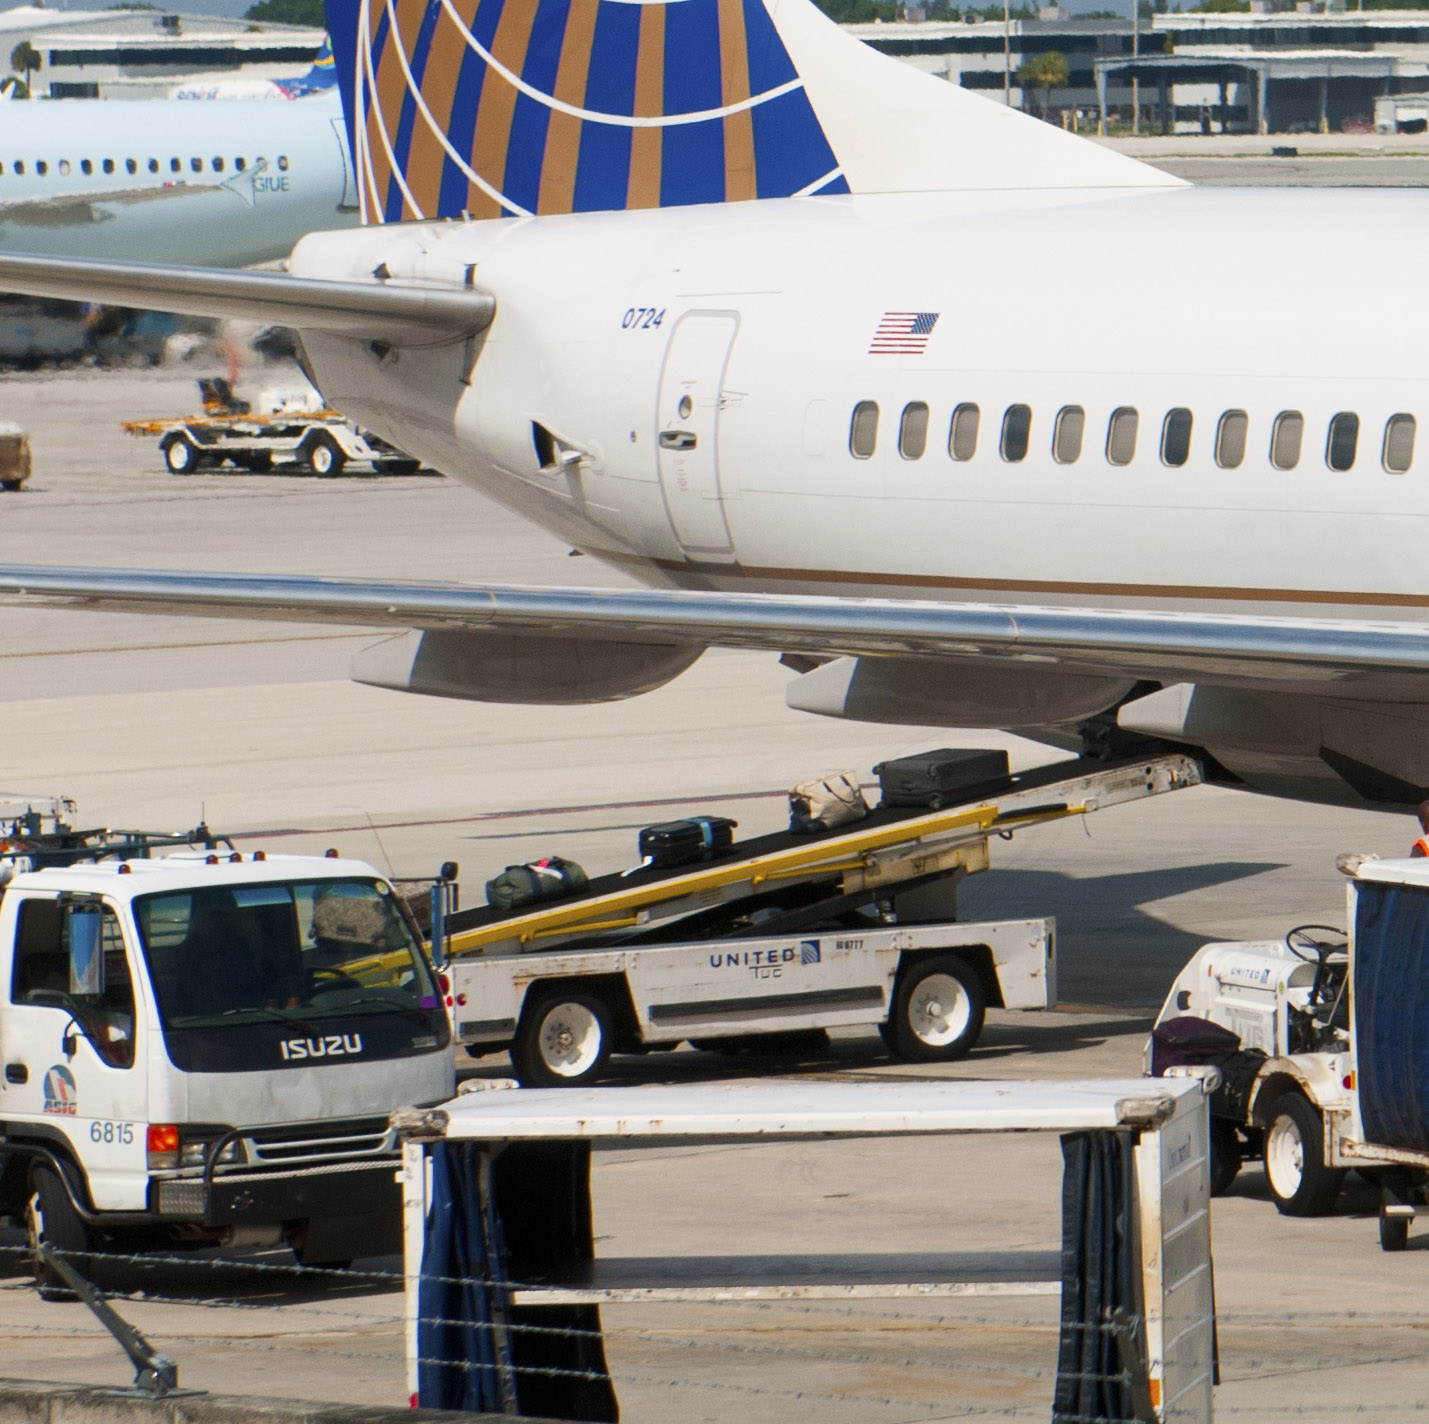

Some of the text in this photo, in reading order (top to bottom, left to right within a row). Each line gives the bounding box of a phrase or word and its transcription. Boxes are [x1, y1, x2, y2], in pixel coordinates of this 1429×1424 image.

[621, 307, 667, 329] 0724
[710, 948, 795, 968] UNITED
[1231, 967, 1261, 980] UNITED
[280, 1033, 363, 1061] ISUZU
[90, 1121, 134, 1144] 6815
